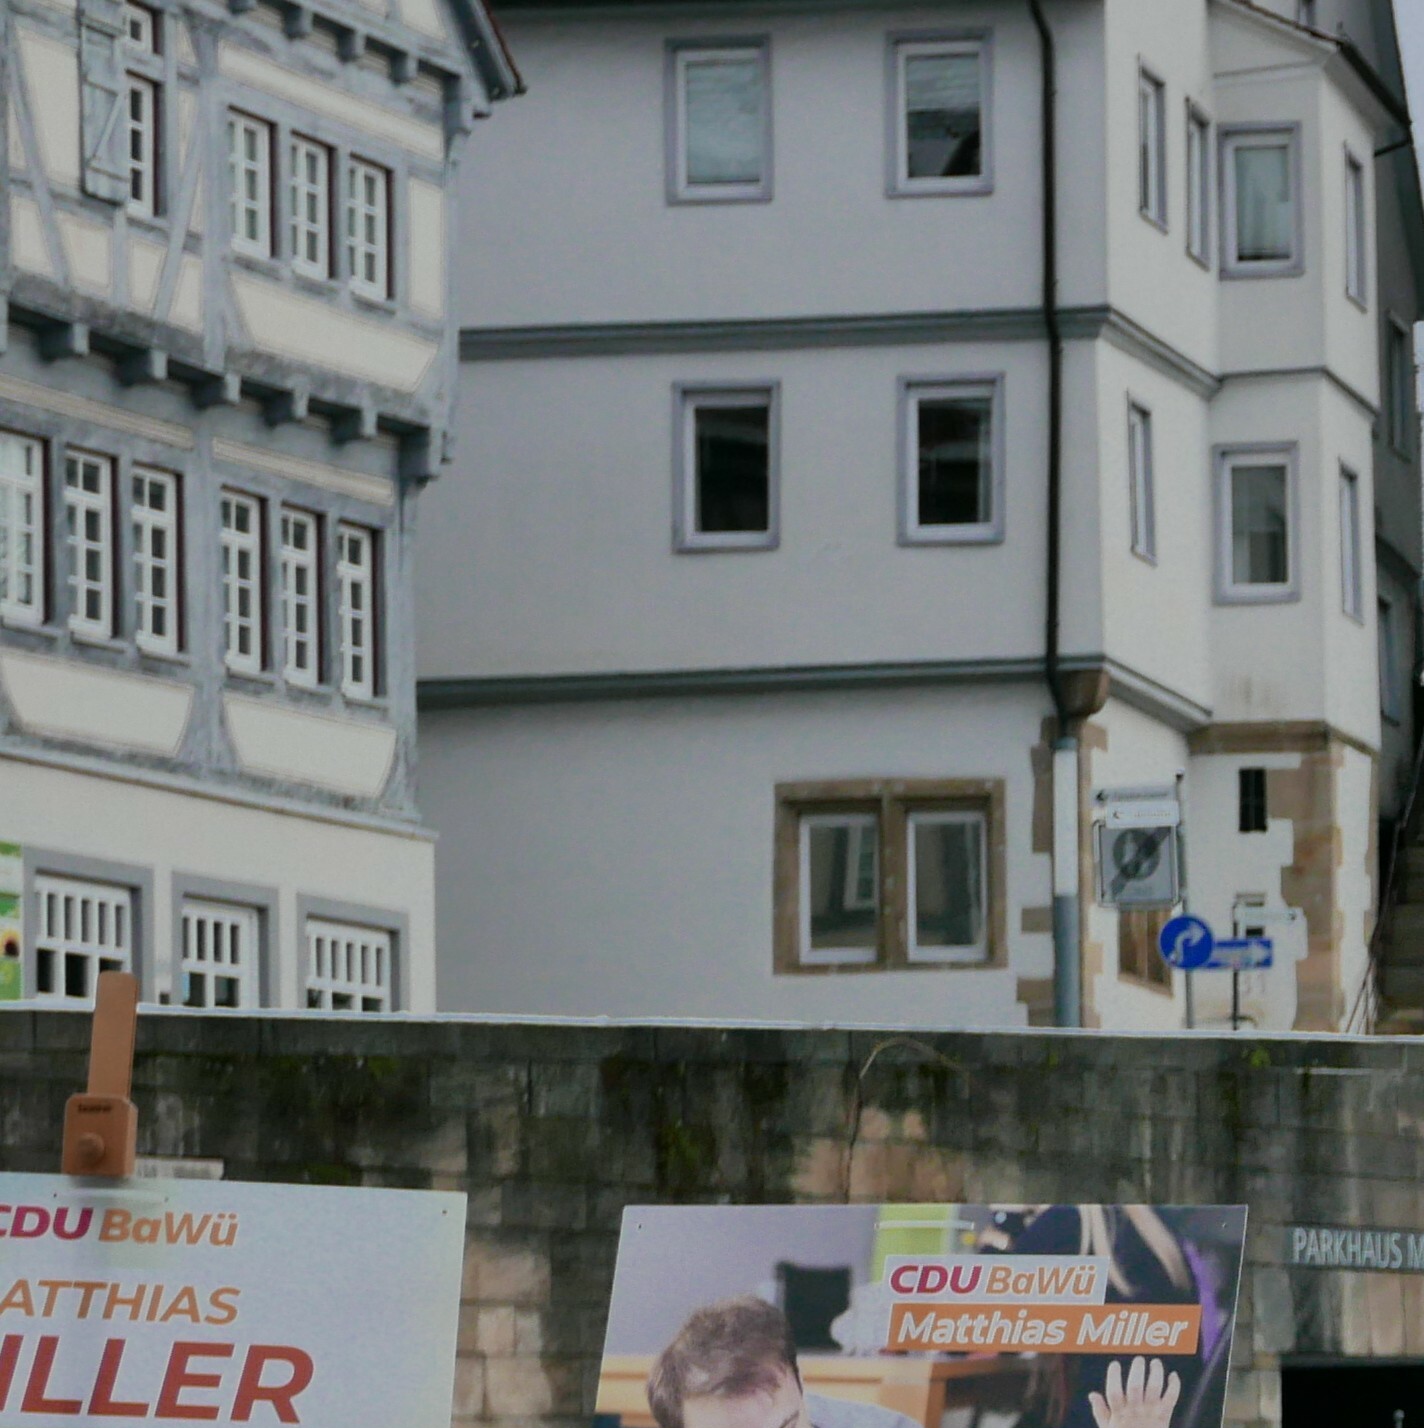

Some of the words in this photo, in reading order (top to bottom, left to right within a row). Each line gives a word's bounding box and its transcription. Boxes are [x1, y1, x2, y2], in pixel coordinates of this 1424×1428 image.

[99, 1208, 239, 1247] BaWü
[1292, 1227, 1401, 1269] PARKHAUS
[890, 1265, 982, 1296] CDU
[986, 1265, 1096, 1296] BaWü
[898, 1309, 1068, 1346] Matthias
[1077, 1311, 1188, 1347] Miller
